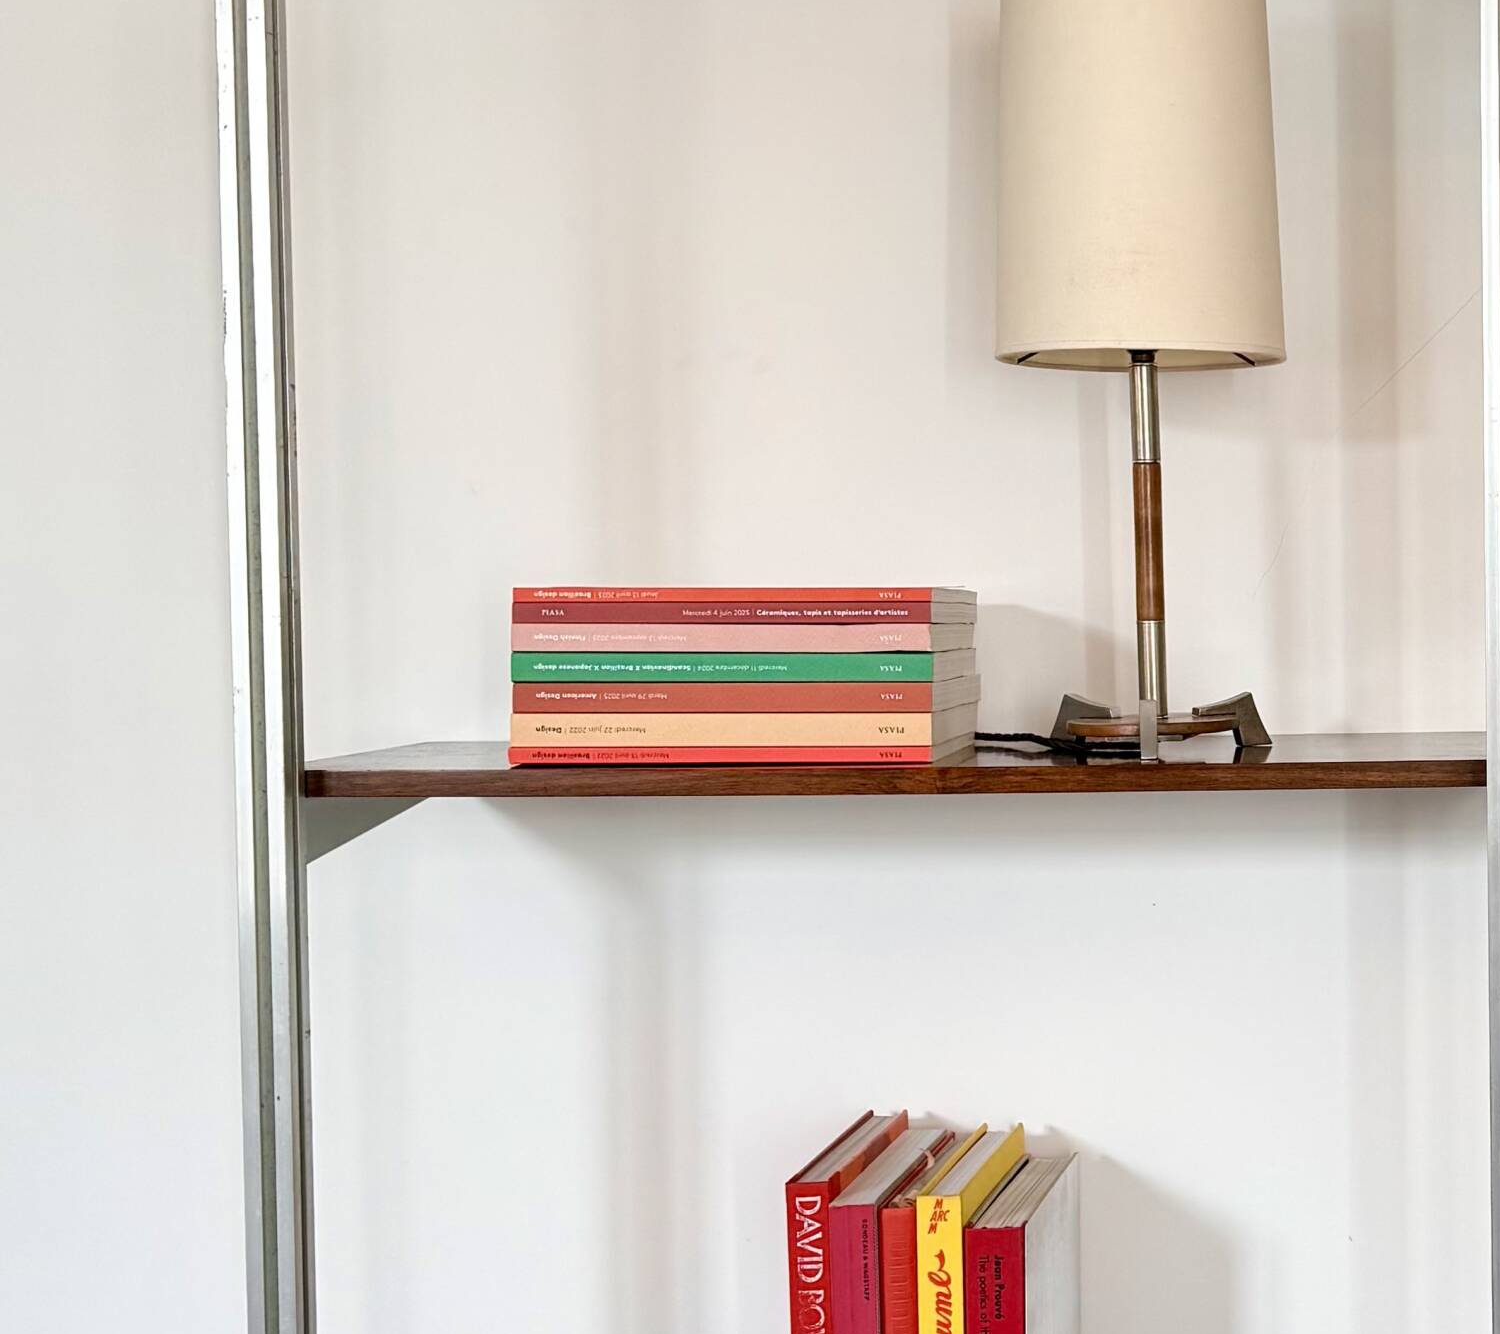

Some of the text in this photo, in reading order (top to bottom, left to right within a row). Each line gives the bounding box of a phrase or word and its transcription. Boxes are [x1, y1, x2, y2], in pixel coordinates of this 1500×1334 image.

[534, 591, 558, 599] design
[720, 609, 732, 617] juin
[804, 609, 822, 617] tapis
[834, 609, 872, 617] tapisseries
[534, 633, 559, 641] Design
[610, 633, 647, 641] septembre
[532, 663, 557, 671] design
[559, 663, 592, 671] Japanese
[536, 691, 560, 700] Design
[536, 725, 562, 733] Design
[588, 725, 602, 733] juin
[532, 751, 556, 759] design
[930, 1210, 950, 1222] ARC
[795, 1195, 823, 1283] DAVID
[979, 1255, 989, 1273] The
[994, 1255, 1005, 1320] Jean Prouvé
[978, 1276, 989, 1309] poetics
[980, 1313, 990, 1323] of
